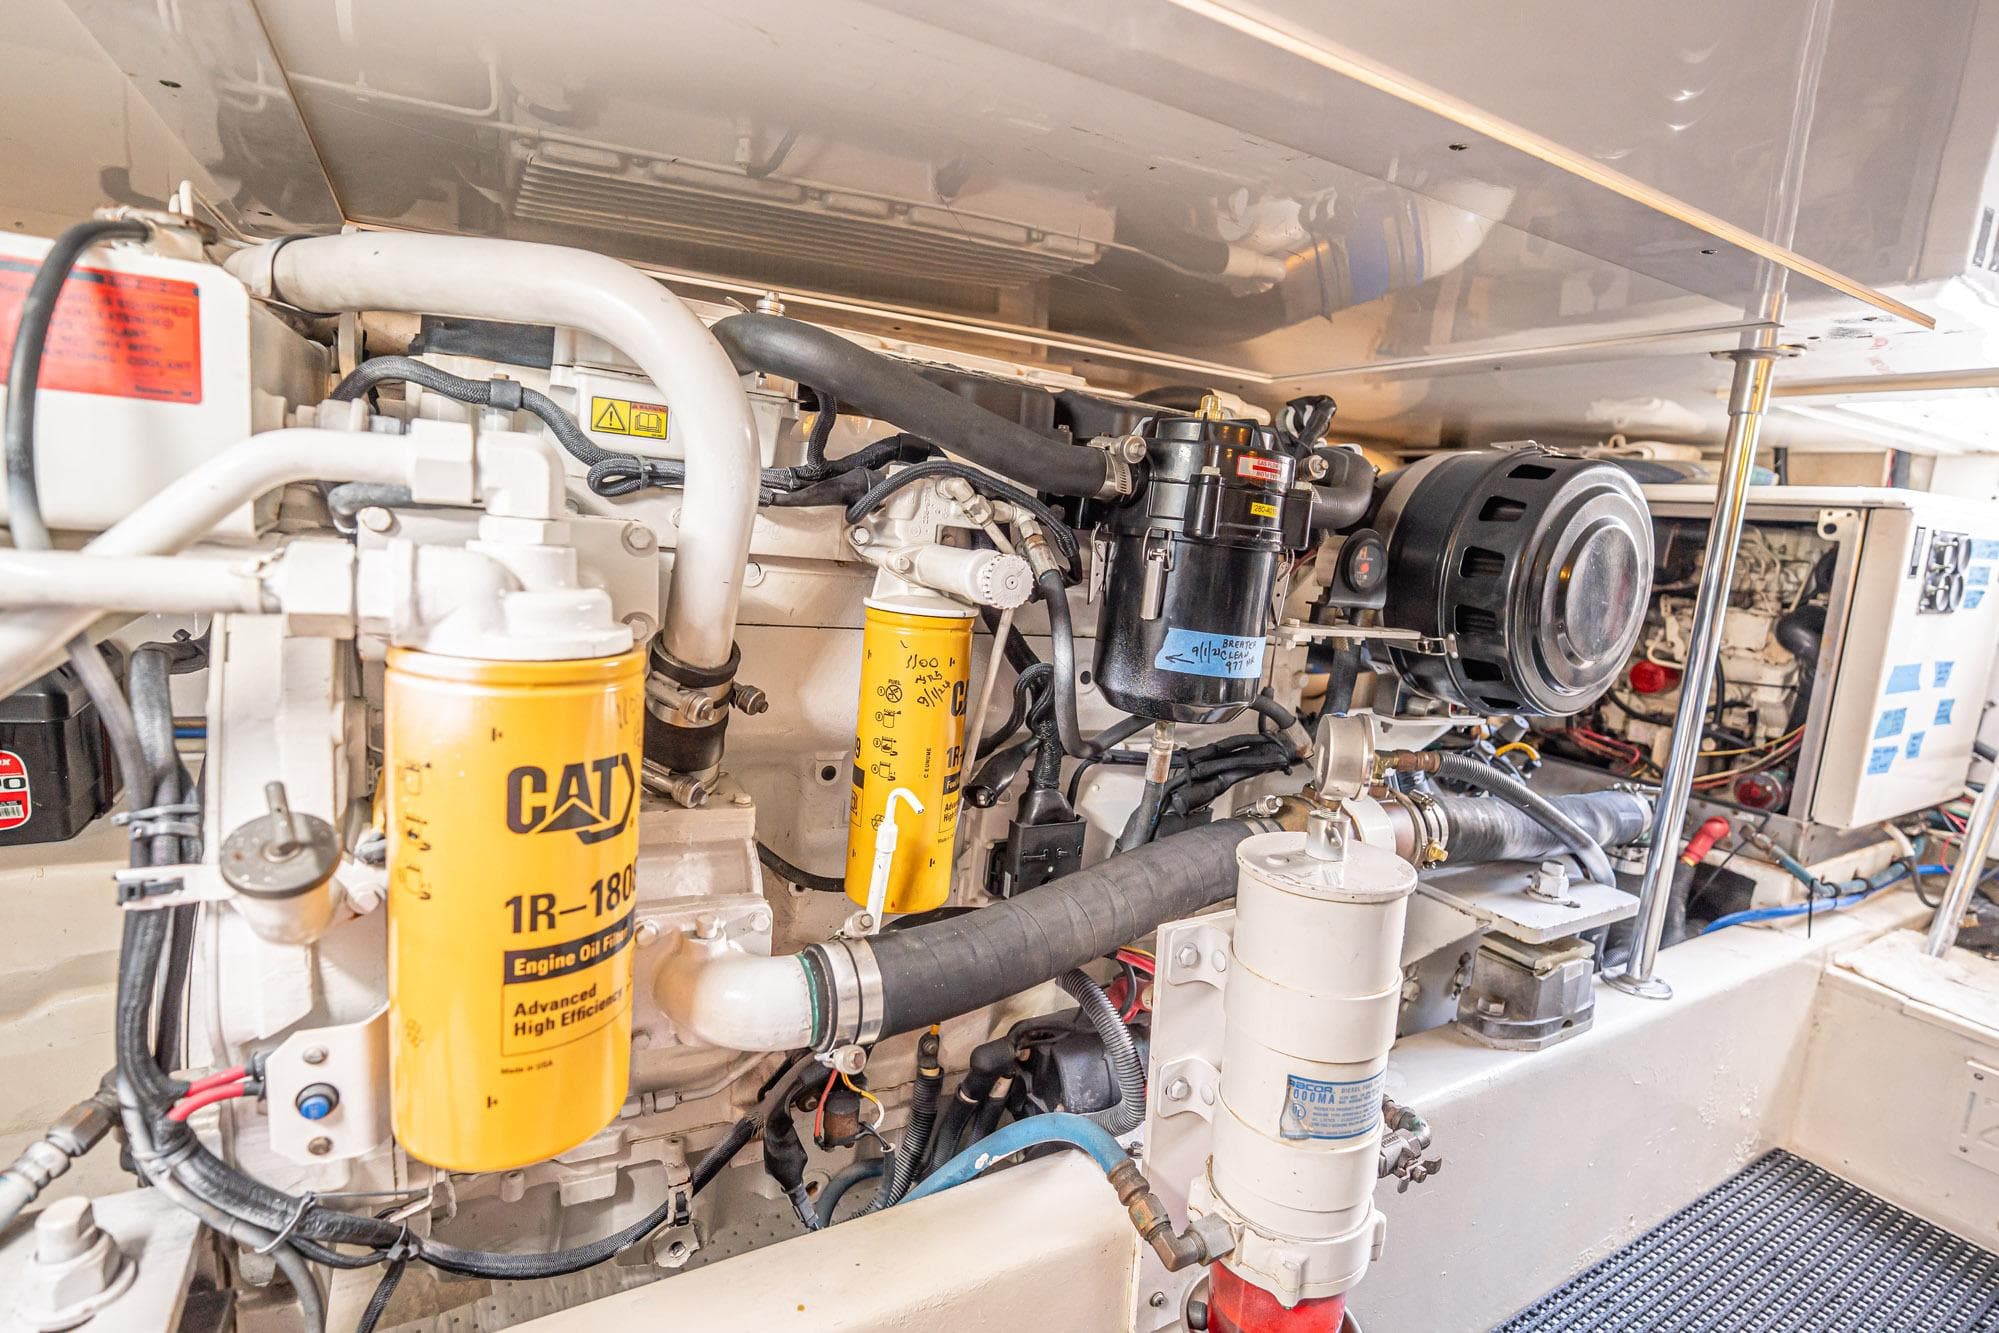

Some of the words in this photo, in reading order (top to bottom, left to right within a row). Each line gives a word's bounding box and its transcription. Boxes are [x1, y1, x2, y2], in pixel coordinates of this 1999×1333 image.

[506, 754, 624, 837] CAT
[513, 952, 576, 976] Engine
[579, 943, 600, 962] Oil
[514, 983, 597, 1017] Advanced
[513, 1015, 556, 1037] High
